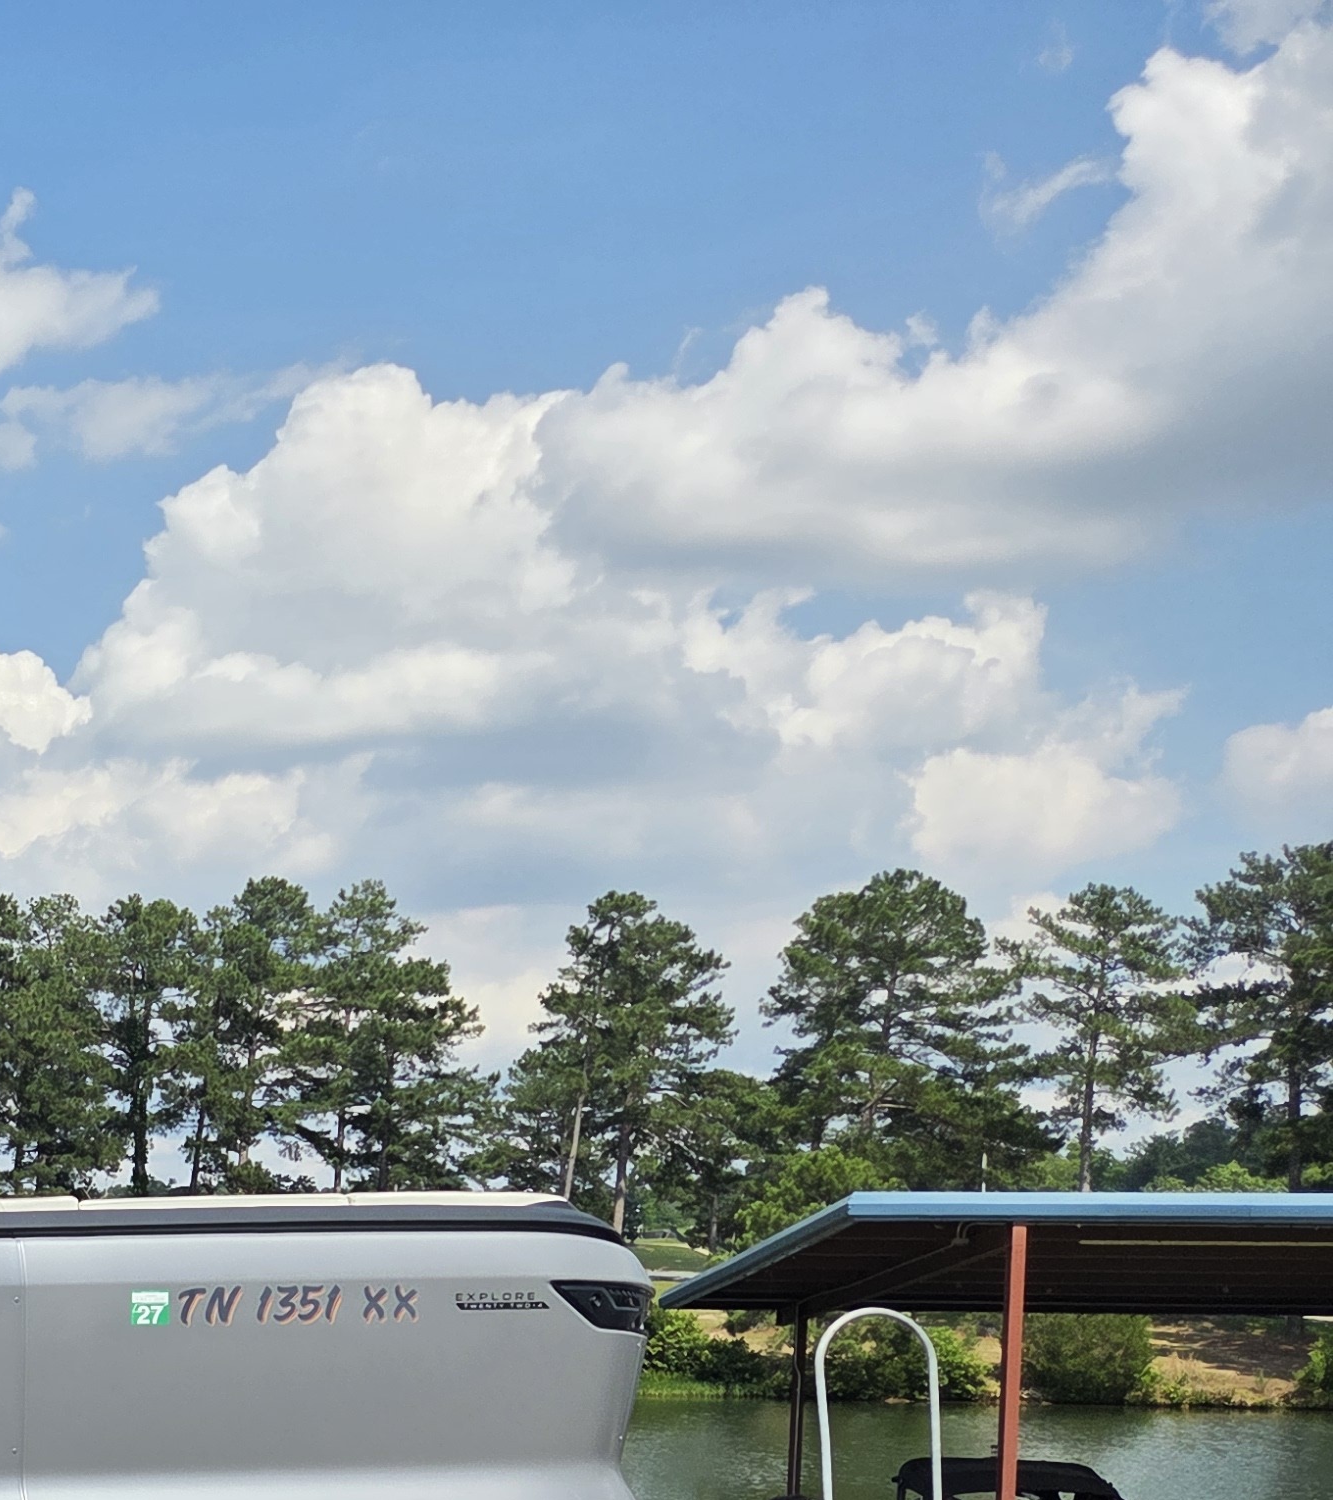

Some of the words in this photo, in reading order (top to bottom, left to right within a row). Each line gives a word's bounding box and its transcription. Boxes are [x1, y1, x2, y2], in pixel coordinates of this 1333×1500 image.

[178, 1285, 243, 1327] TN
[256, 1284, 342, 1325] 1351
[363, 1284, 419, 1324] XX
[455, 1292, 535, 1301] EXPLORE
